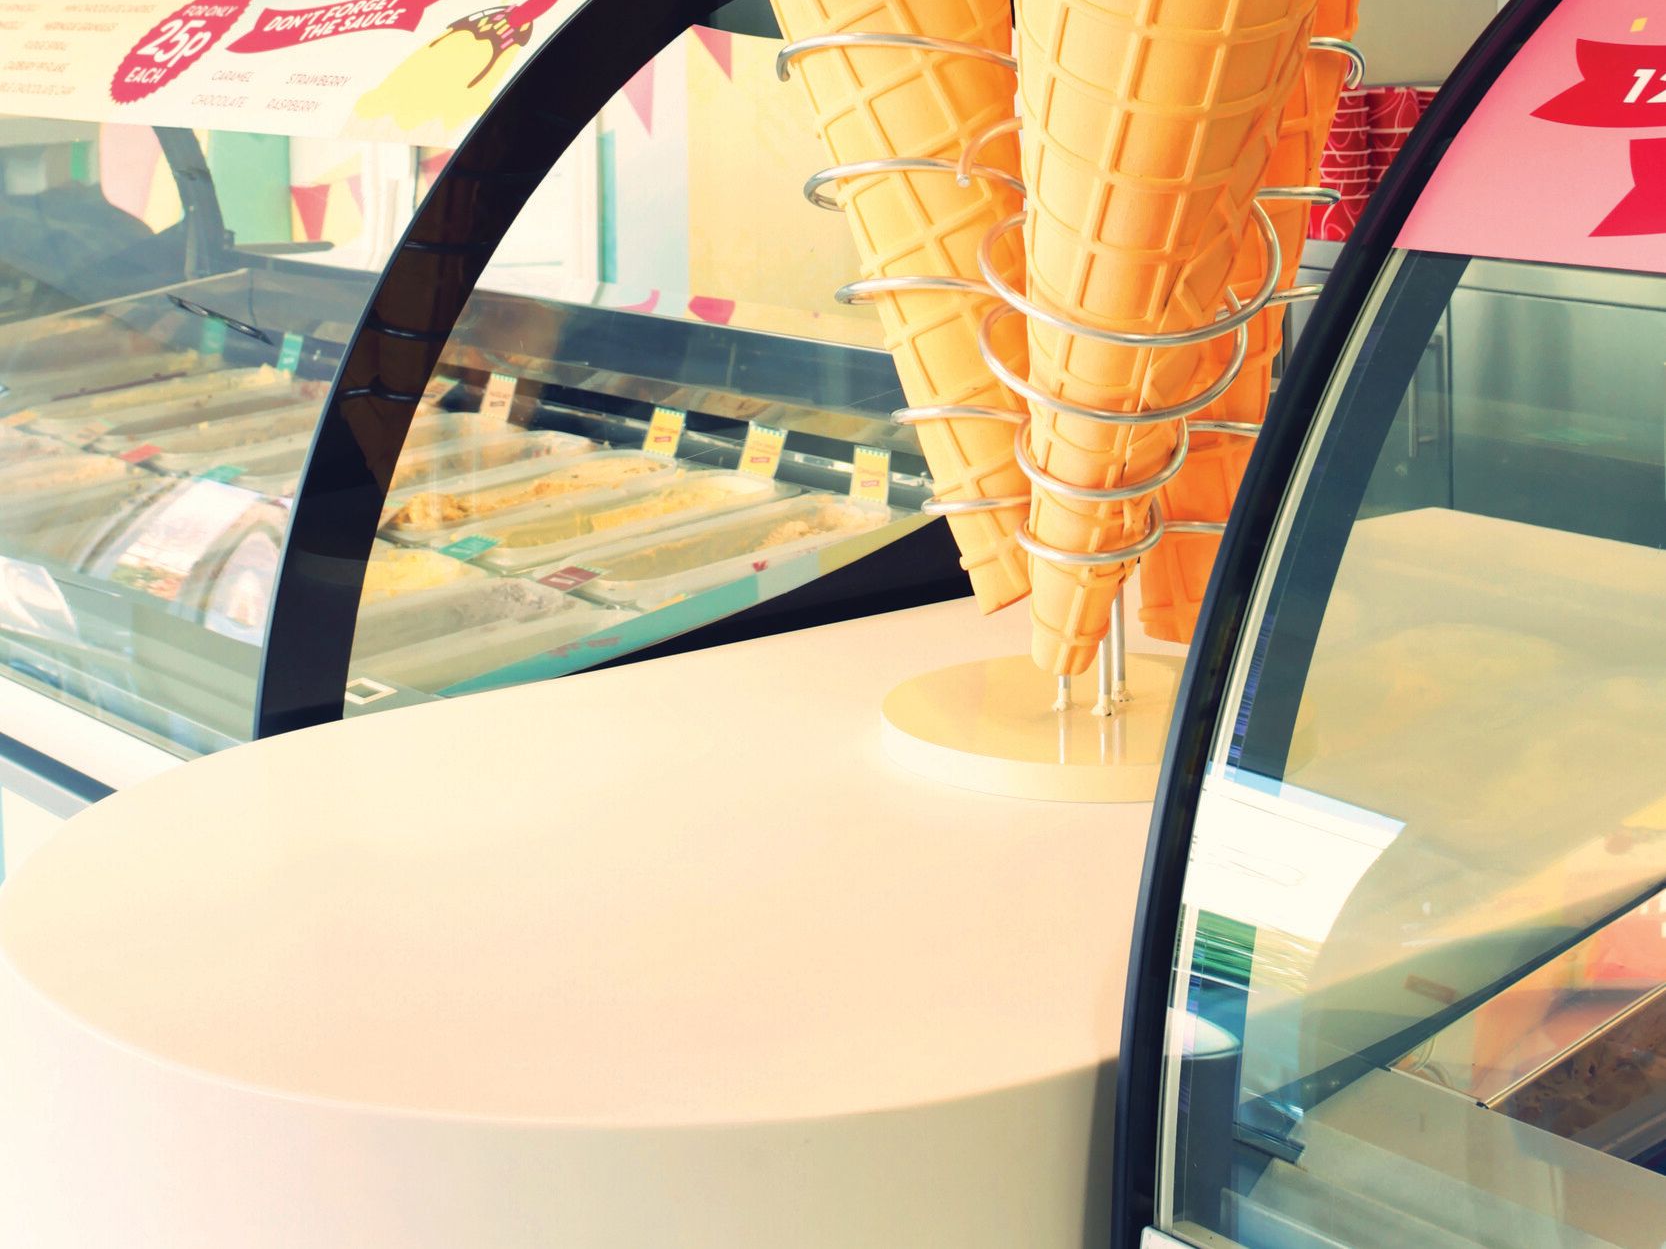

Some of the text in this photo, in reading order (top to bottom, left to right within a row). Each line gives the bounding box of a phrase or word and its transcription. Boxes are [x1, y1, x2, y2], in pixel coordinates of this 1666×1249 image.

[263, 10, 324, 32] DON'T
[299, 8, 407, 41] THE SAUCE
[124, 67, 168, 84] EACH
